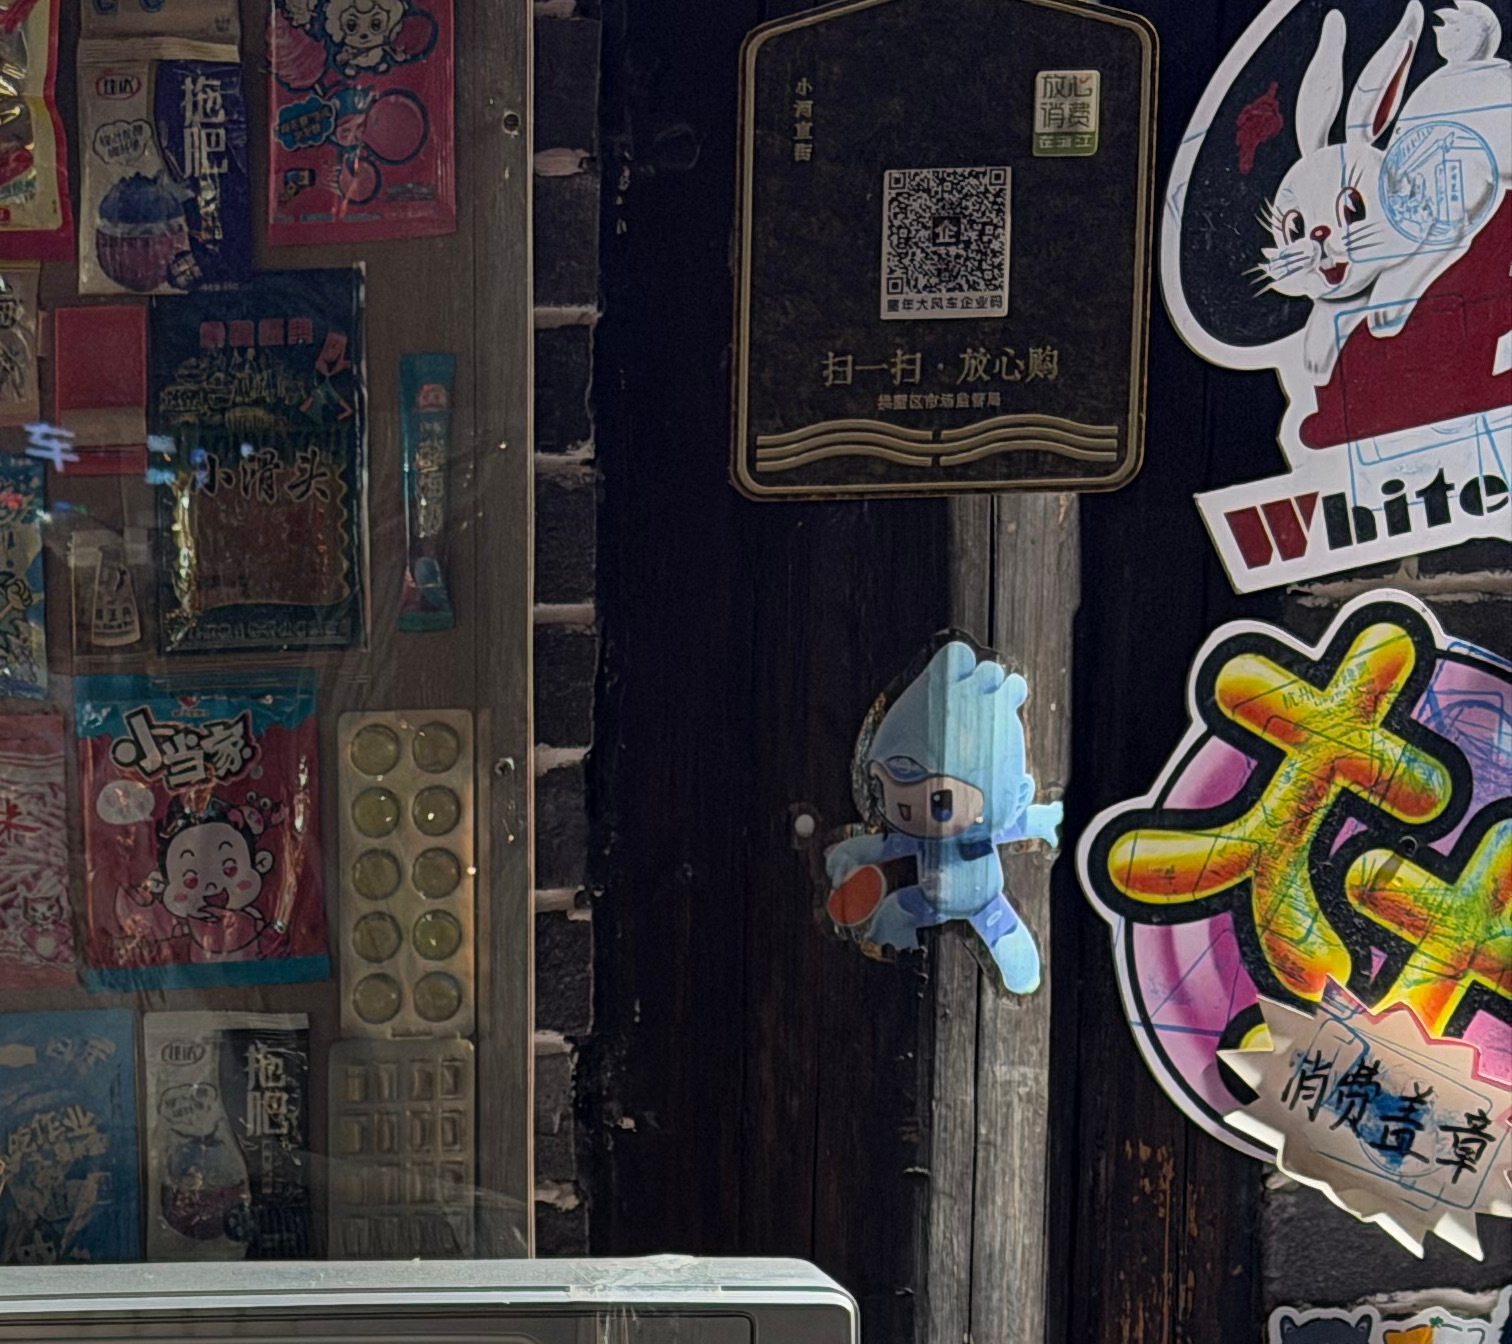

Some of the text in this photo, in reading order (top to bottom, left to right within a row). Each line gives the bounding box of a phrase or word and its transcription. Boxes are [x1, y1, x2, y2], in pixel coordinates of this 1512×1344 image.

[190, 445, 331, 503] 小滑头
[1224, 468, 1512, 570] White
[112, 707, 255, 788] 小当家
